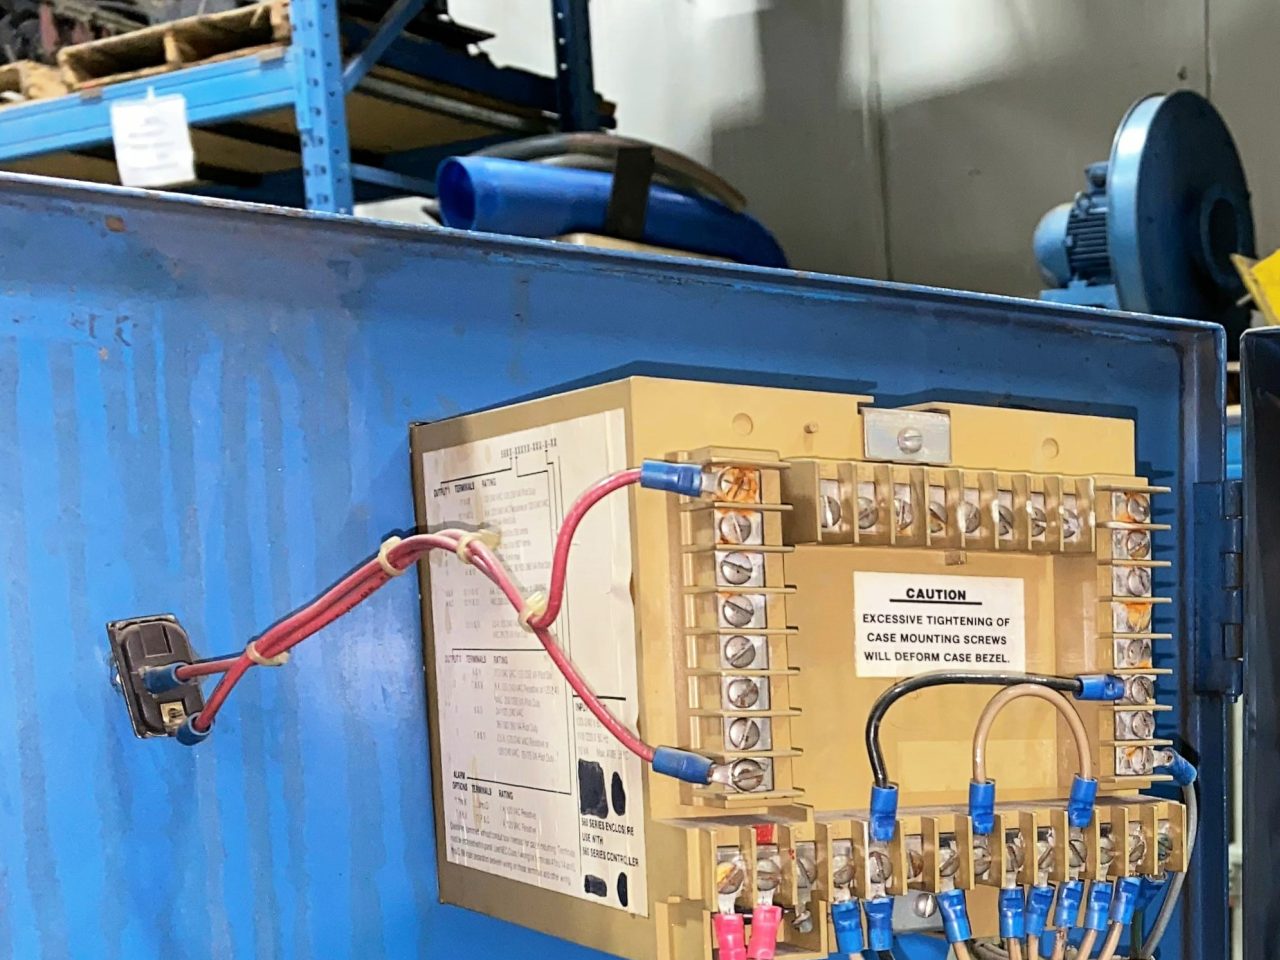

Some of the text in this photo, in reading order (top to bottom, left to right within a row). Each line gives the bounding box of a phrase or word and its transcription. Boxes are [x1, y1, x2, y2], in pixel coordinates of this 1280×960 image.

[454, 482, 474, 493] TERMINALS
[906, 588, 966, 600] CAUTION
[863, 614, 1010, 626] EXCESSIVE TIGHTENING OF
[867, 633, 1007, 644] CASE MOUNTING SCREWS
[864, 652, 1010, 663] WILL DEFORM CASE BEZEL.
[472, 784, 492, 796] TERMINALS
[589, 819, 604, 830] SERIES
[582, 833, 604, 844] USE WITH
[590, 848, 606, 860] SERIES
[607, 852, 638, 866] CONTROLLER
